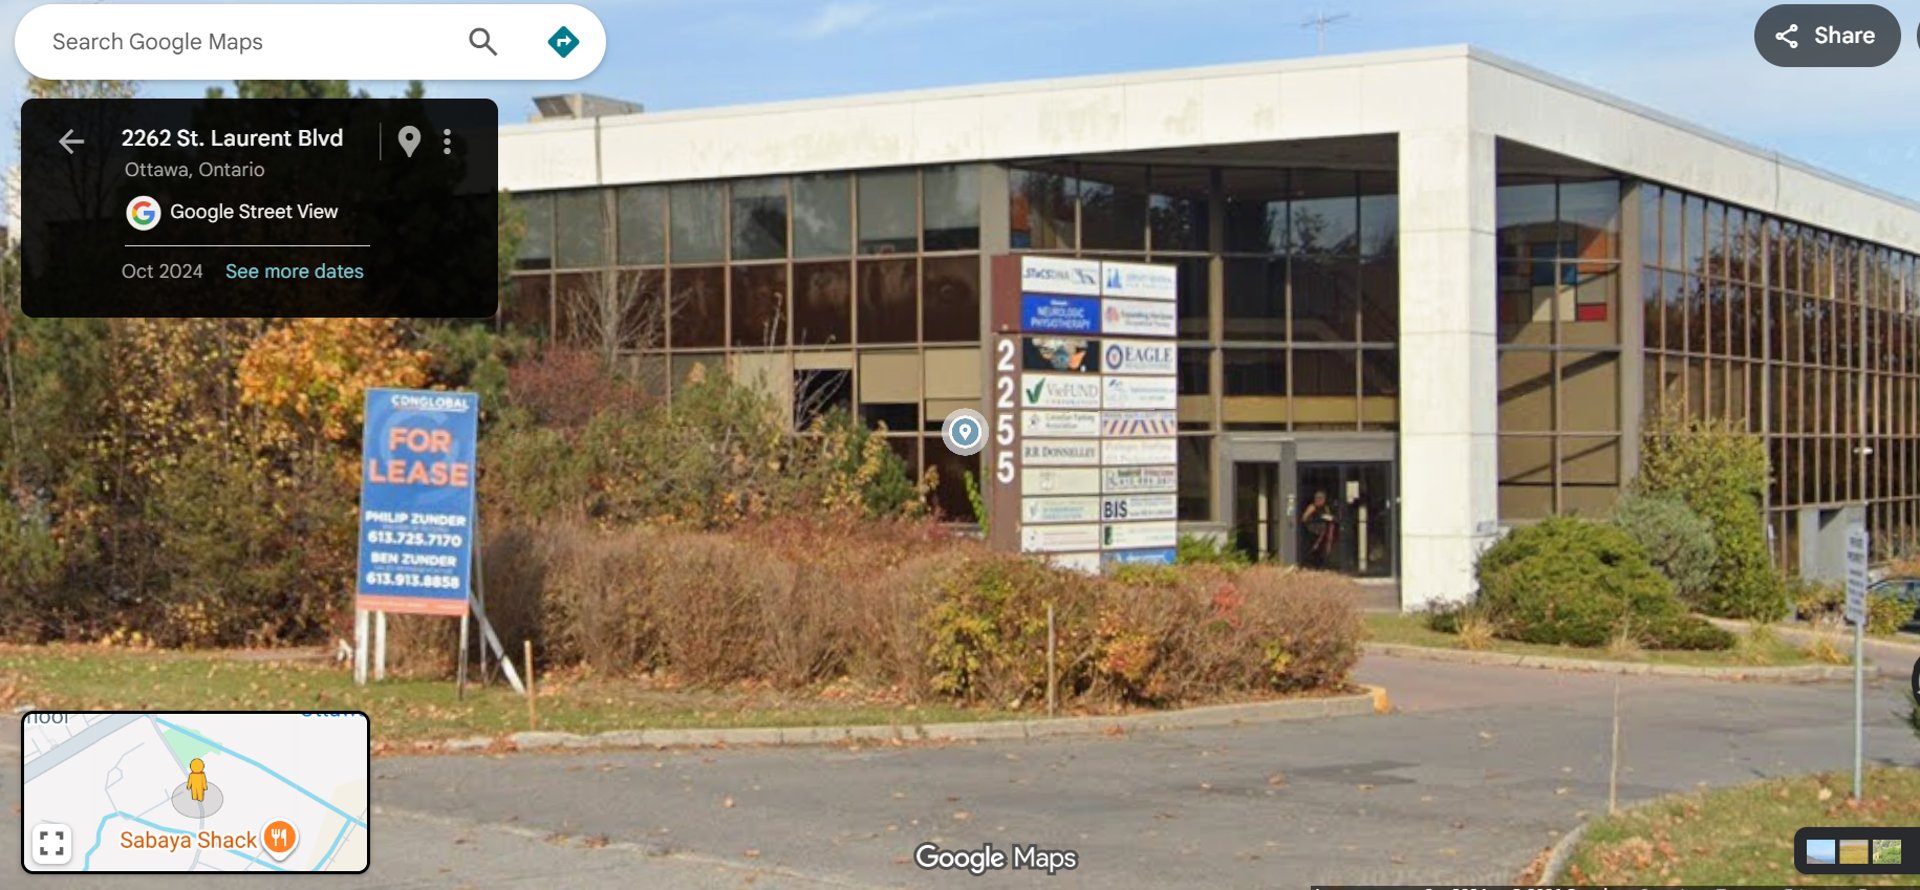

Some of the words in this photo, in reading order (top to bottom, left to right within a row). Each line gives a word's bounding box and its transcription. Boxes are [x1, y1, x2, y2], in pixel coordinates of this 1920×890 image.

[1031, 317, 1090, 330] PHYSIOTHERAPY
[1125, 346, 1173, 362] EAGLE
[389, 426, 454, 454] FOR
[368, 458, 470, 488] LEASE
[1104, 500, 1128, 518] BIS
[365, 510, 409, 525] PHILIP
[411, 513, 466, 527] ZUNDER
[368, 530, 463, 548] 613.725.7170
[370, 551, 399, 565] BEN
[401, 553, 458, 568] ZUNDER
[366, 571, 461, 589] 613.913.8858
